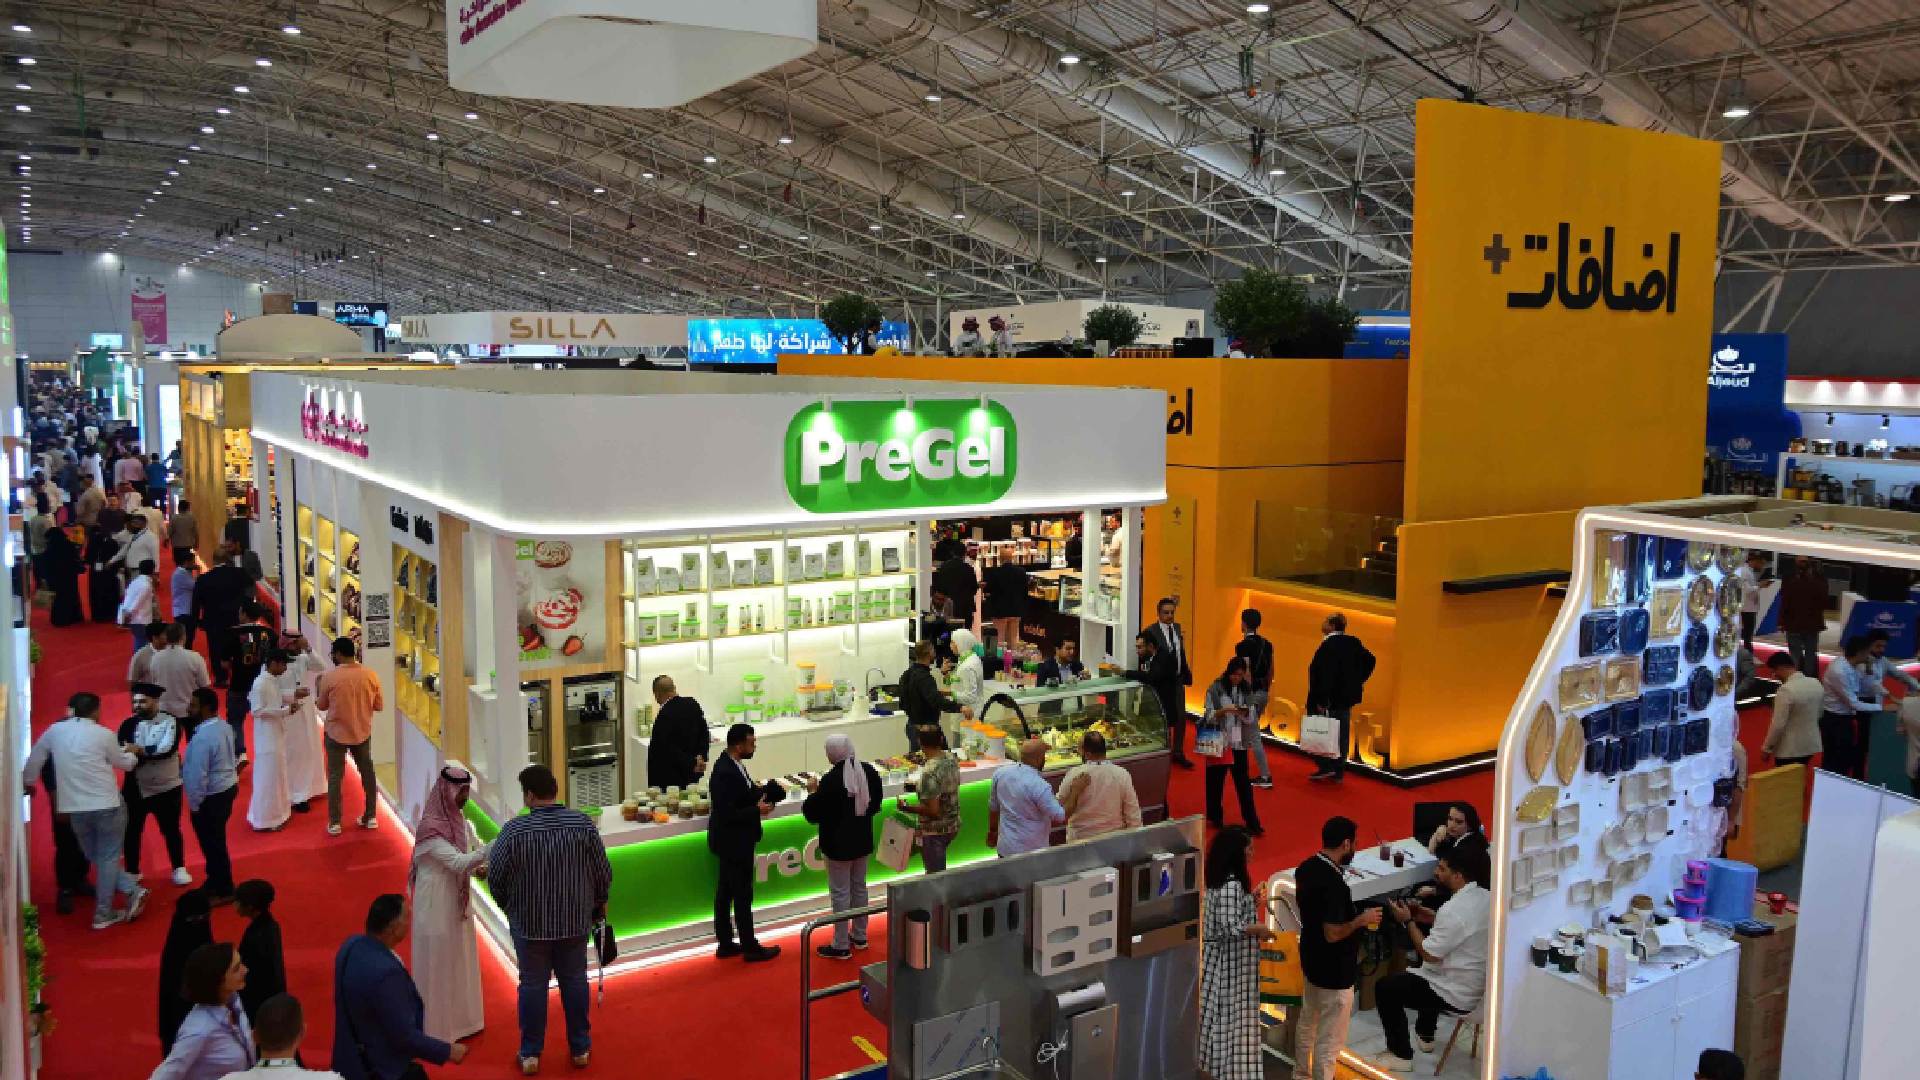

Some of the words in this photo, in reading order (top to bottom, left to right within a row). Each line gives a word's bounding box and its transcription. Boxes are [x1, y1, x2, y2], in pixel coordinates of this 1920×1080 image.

[510, 316, 616, 339] SILLA
[778, 332, 832, 355] شراكة
[801, 426, 1005, 486] PreGel
